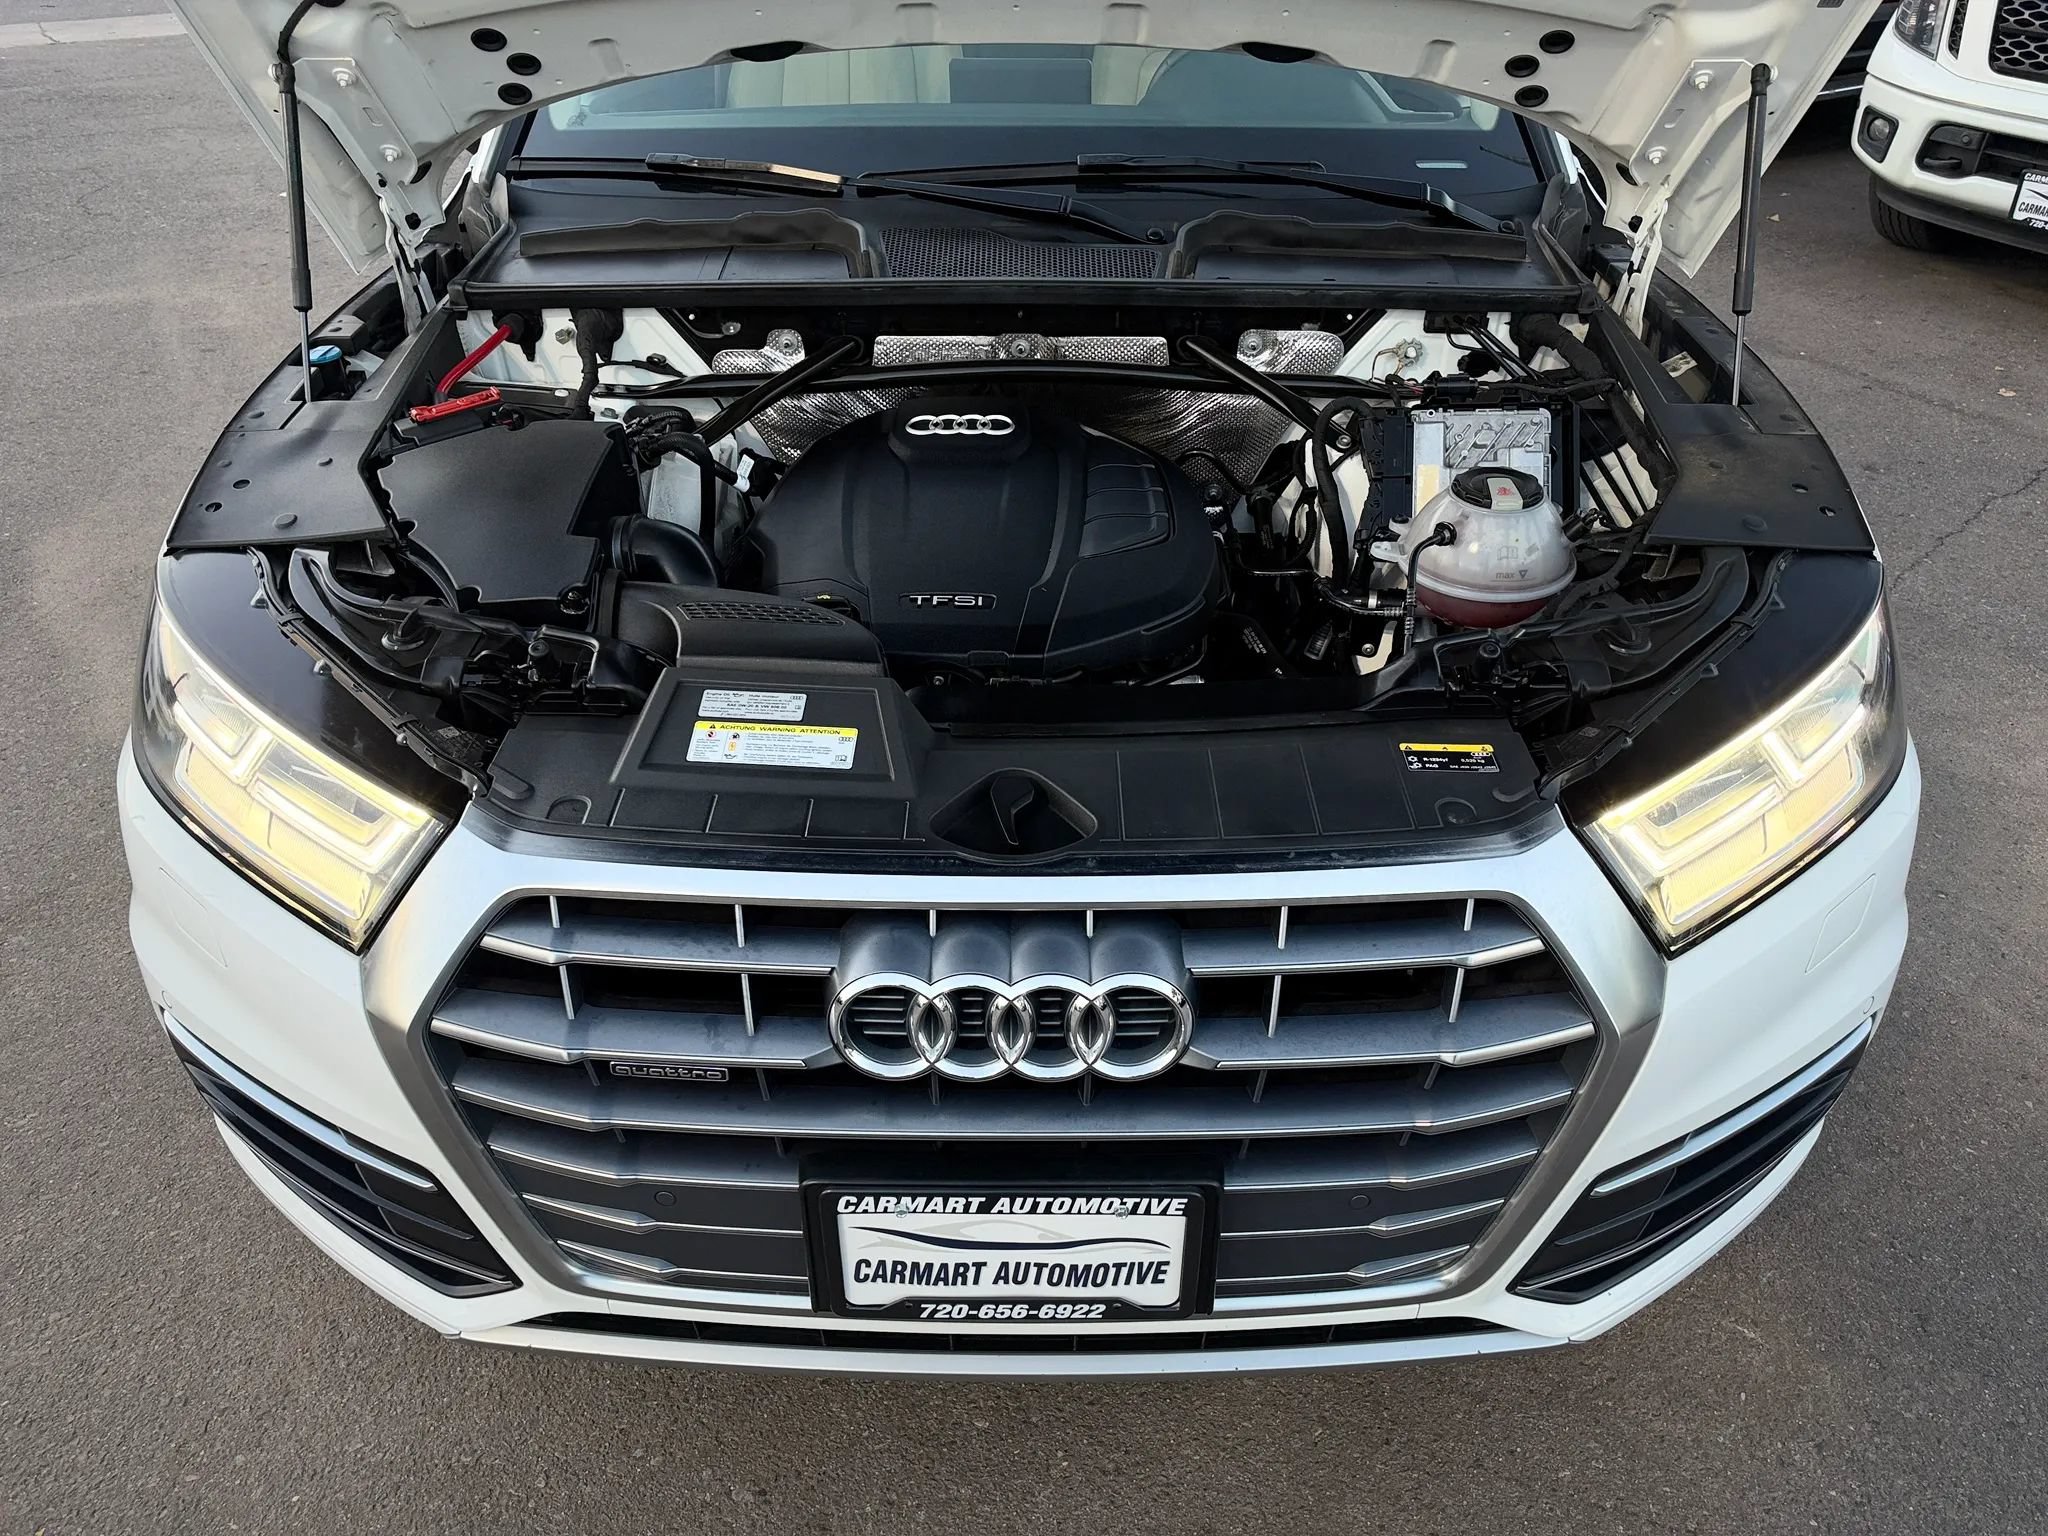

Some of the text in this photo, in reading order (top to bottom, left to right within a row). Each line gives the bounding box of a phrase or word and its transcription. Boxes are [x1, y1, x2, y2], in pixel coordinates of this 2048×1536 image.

[1495, 571, 1515, 580] max
[909, 595, 983, 606] TFSI
[615, 1065, 722, 1078] quattro
[836, 1195, 1188, 1216] CARMART AUTOMOTIVE
[853, 1259, 1171, 1288] CARMART AUTOMOTIVE
[919, 1303, 1108, 1320] 720-656-6922
